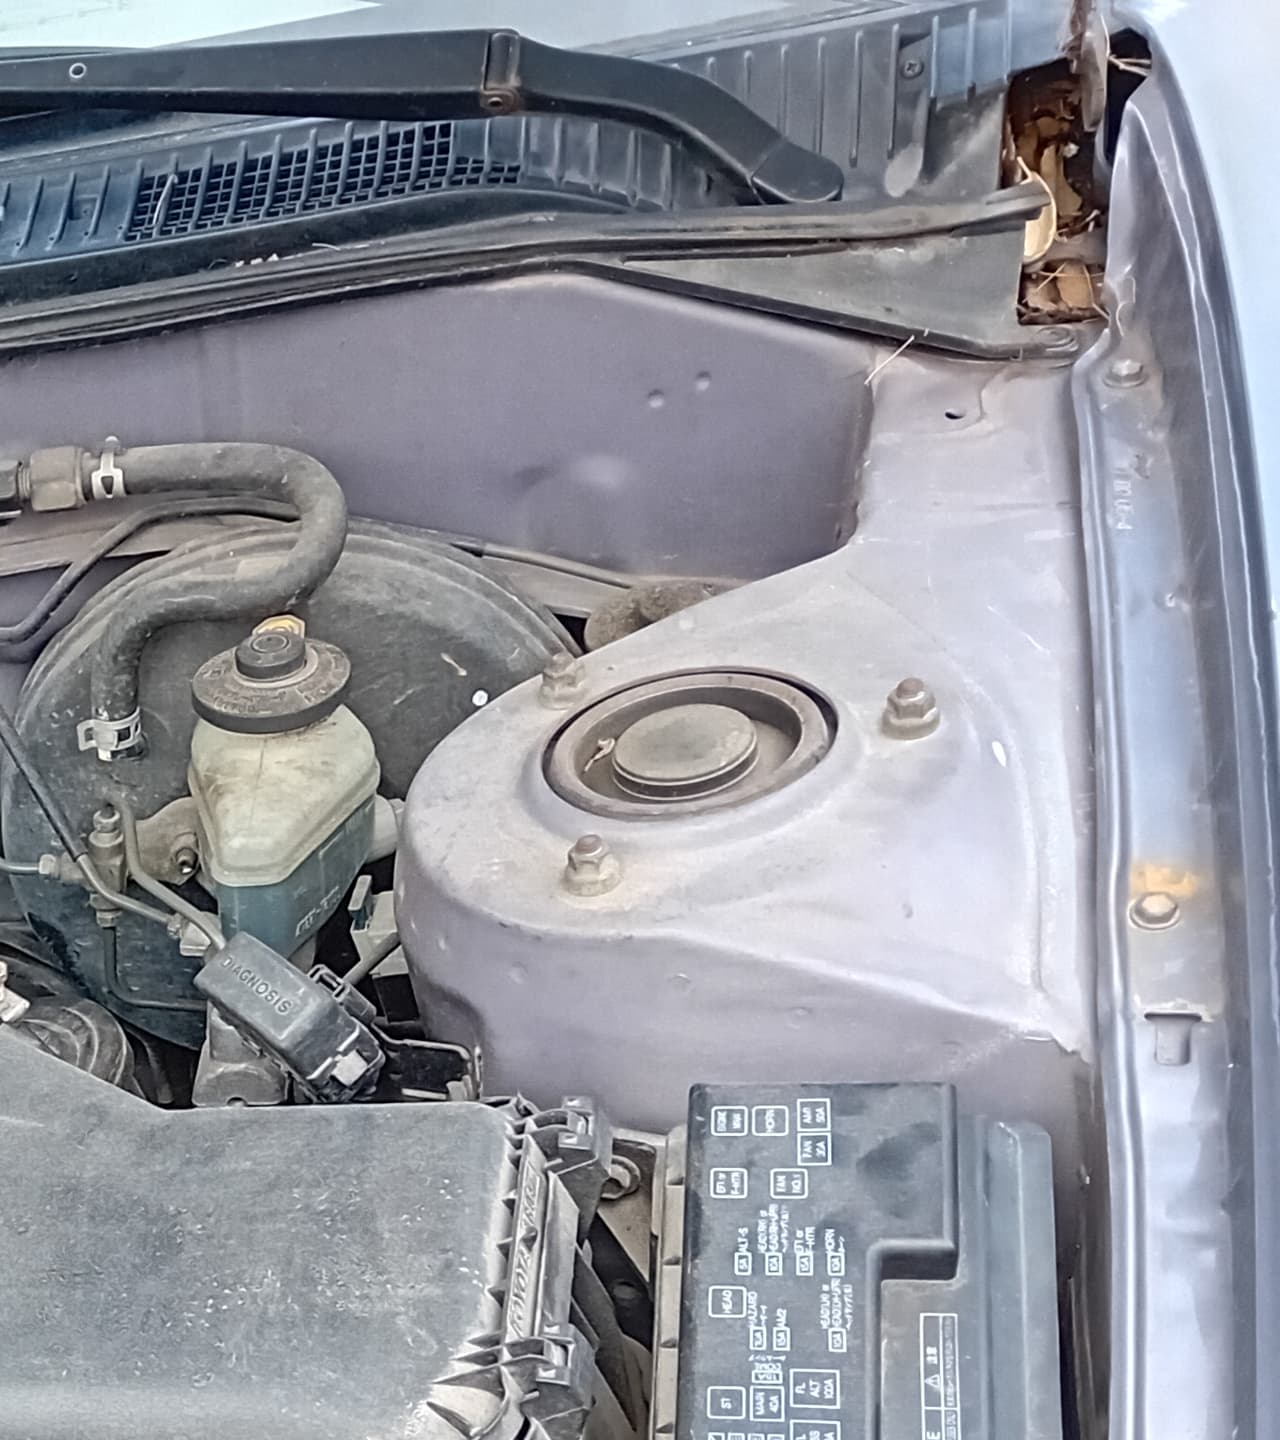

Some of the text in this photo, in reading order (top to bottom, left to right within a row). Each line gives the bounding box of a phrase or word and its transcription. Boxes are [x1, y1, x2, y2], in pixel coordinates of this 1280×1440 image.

[220, 955, 292, 1015] DIAGNOSIS
[721, 1290, 733, 1314] HEAD
[809, 1379, 820, 1398] ALT
[720, 1397, 732, 1409] ST
